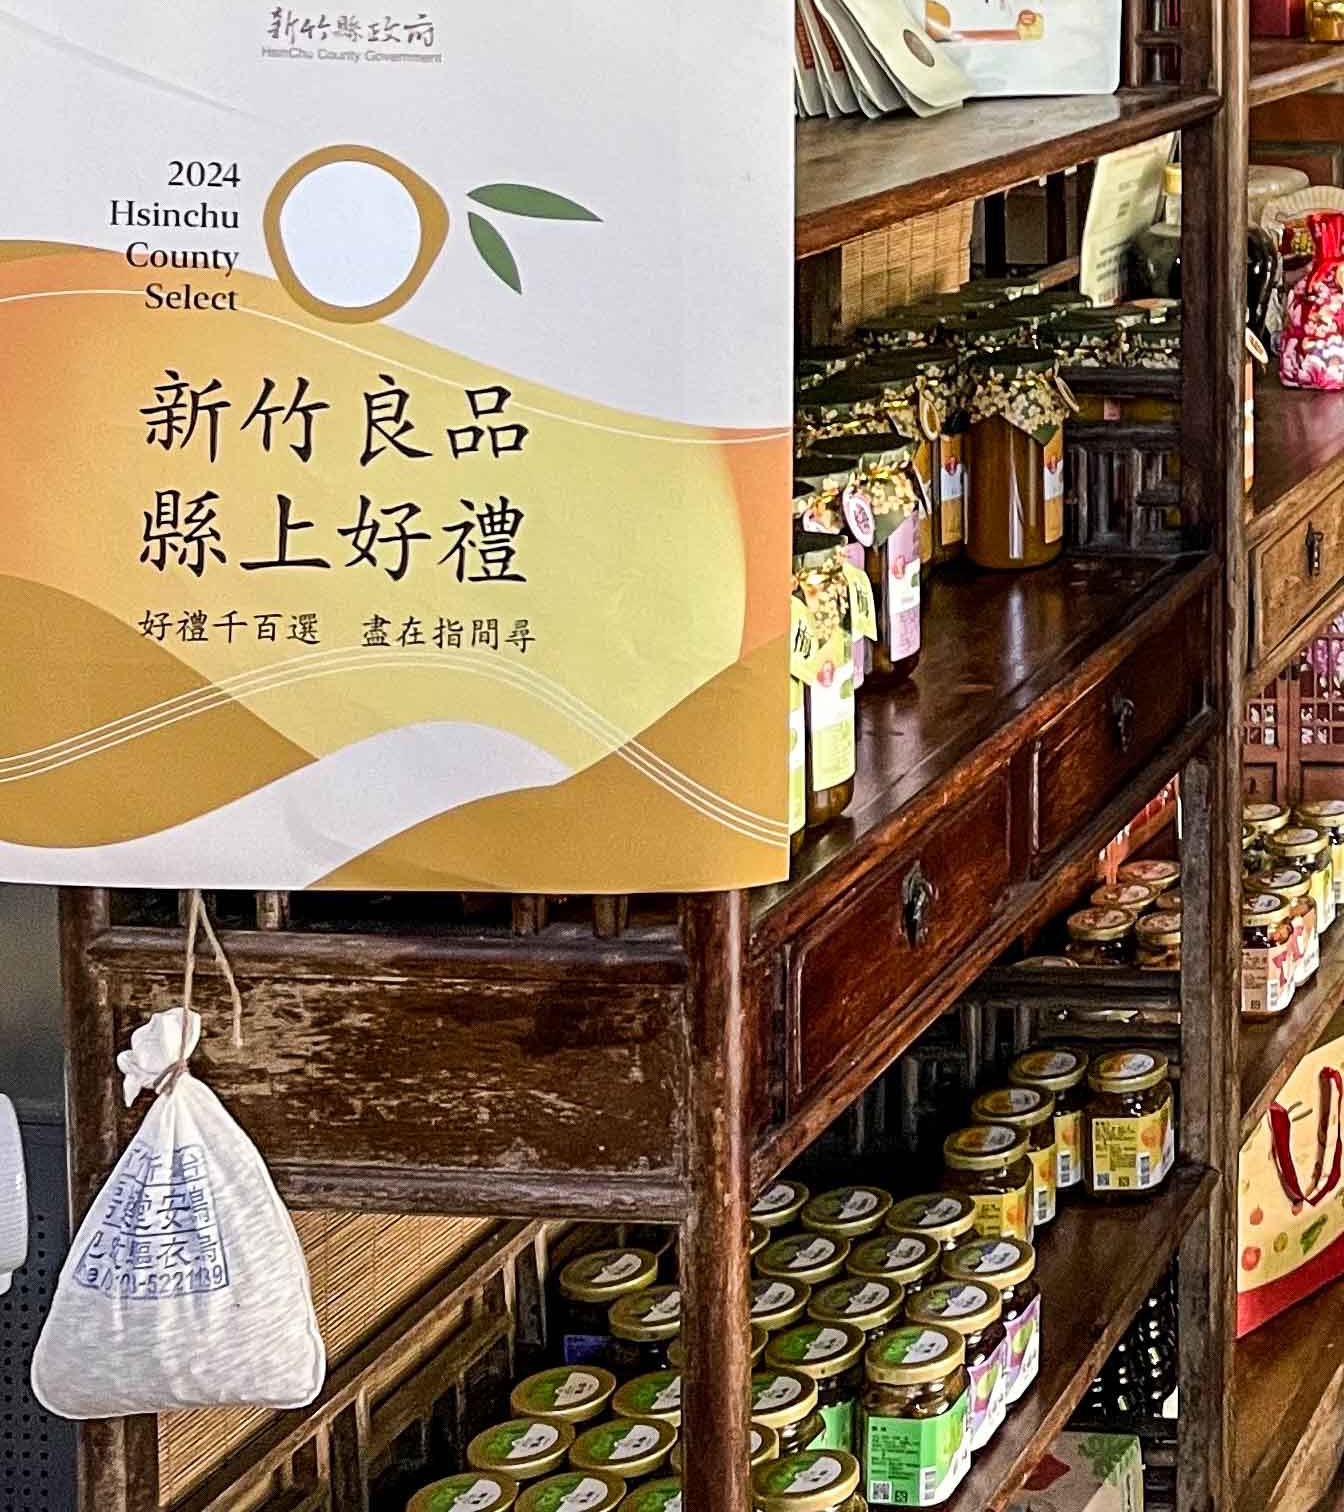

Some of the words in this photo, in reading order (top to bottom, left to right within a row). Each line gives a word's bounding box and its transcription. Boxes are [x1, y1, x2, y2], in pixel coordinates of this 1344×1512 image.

[267, 6, 436, 47] 新竹縣政府
[317, 48, 362, 64] County
[167, 160, 241, 188] 2024
[109, 199, 240, 229] Hsinchu
[126, 240, 240, 278] County
[144, 281, 240, 311] Select
[139, 369, 530, 467] 新竹良品
[139, 488, 528, 584] 縣上好禮
[138, 609, 322, 646] 好禮千百選
[360, 613, 537, 653] 盡在指間尋
